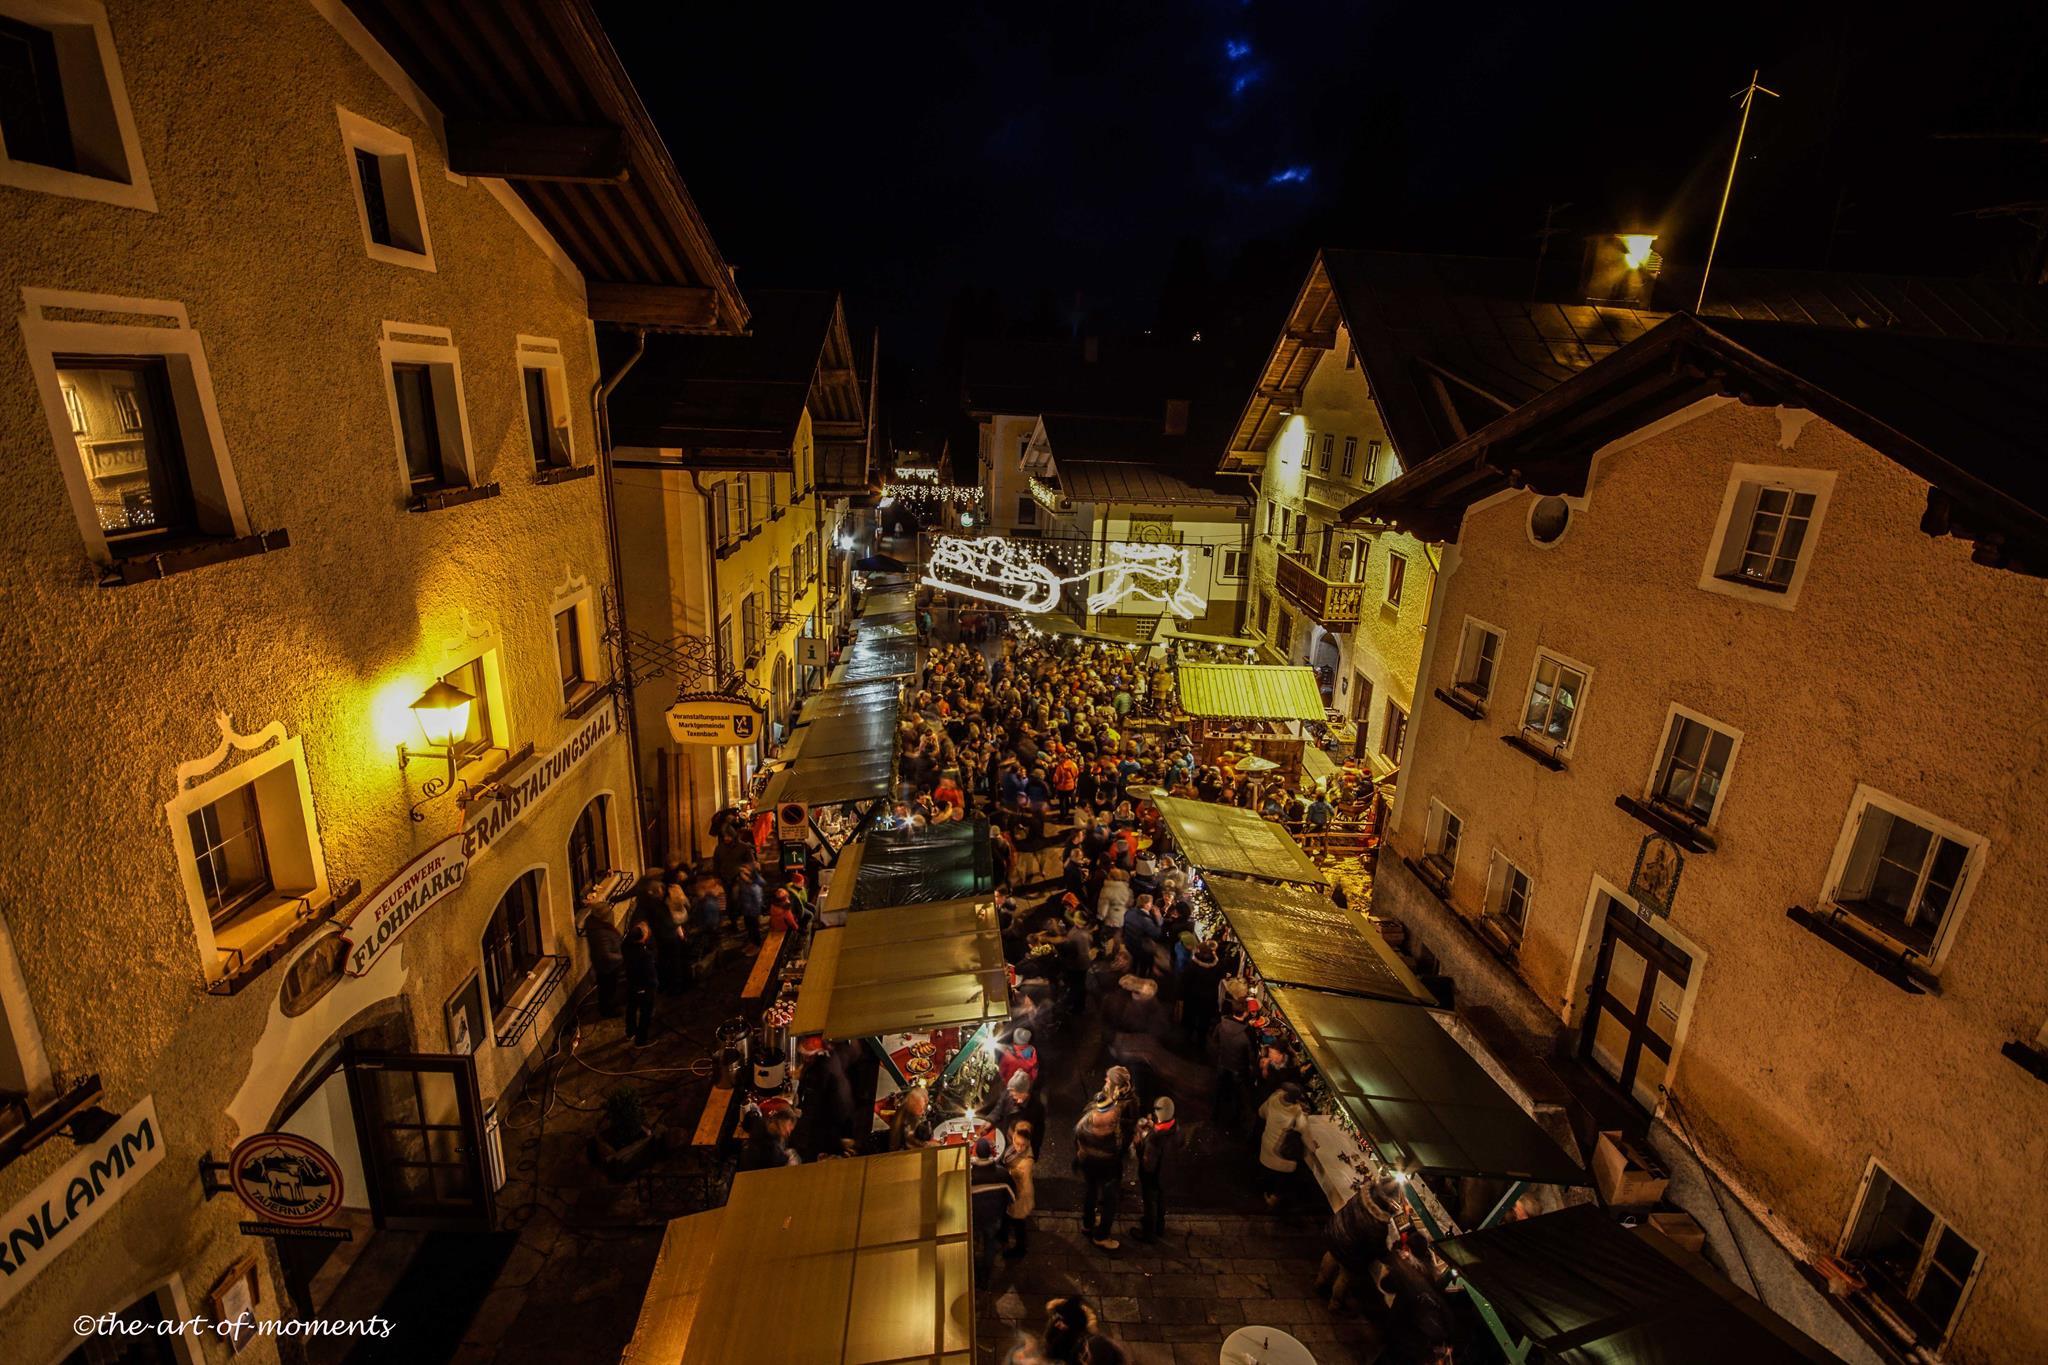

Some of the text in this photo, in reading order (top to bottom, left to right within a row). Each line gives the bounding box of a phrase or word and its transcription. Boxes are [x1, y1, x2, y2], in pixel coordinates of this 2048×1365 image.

[672, 713, 730, 721] Veranstaltungssaal
[463, 710, 611, 858] ERANSTALTUNGSSAAL
[352, 861, 464, 973] FLOHMARKT
[374, 856, 446, 923] FEUERWEHR-
[251, 1189, 327, 1216] TAUERNLAMM
